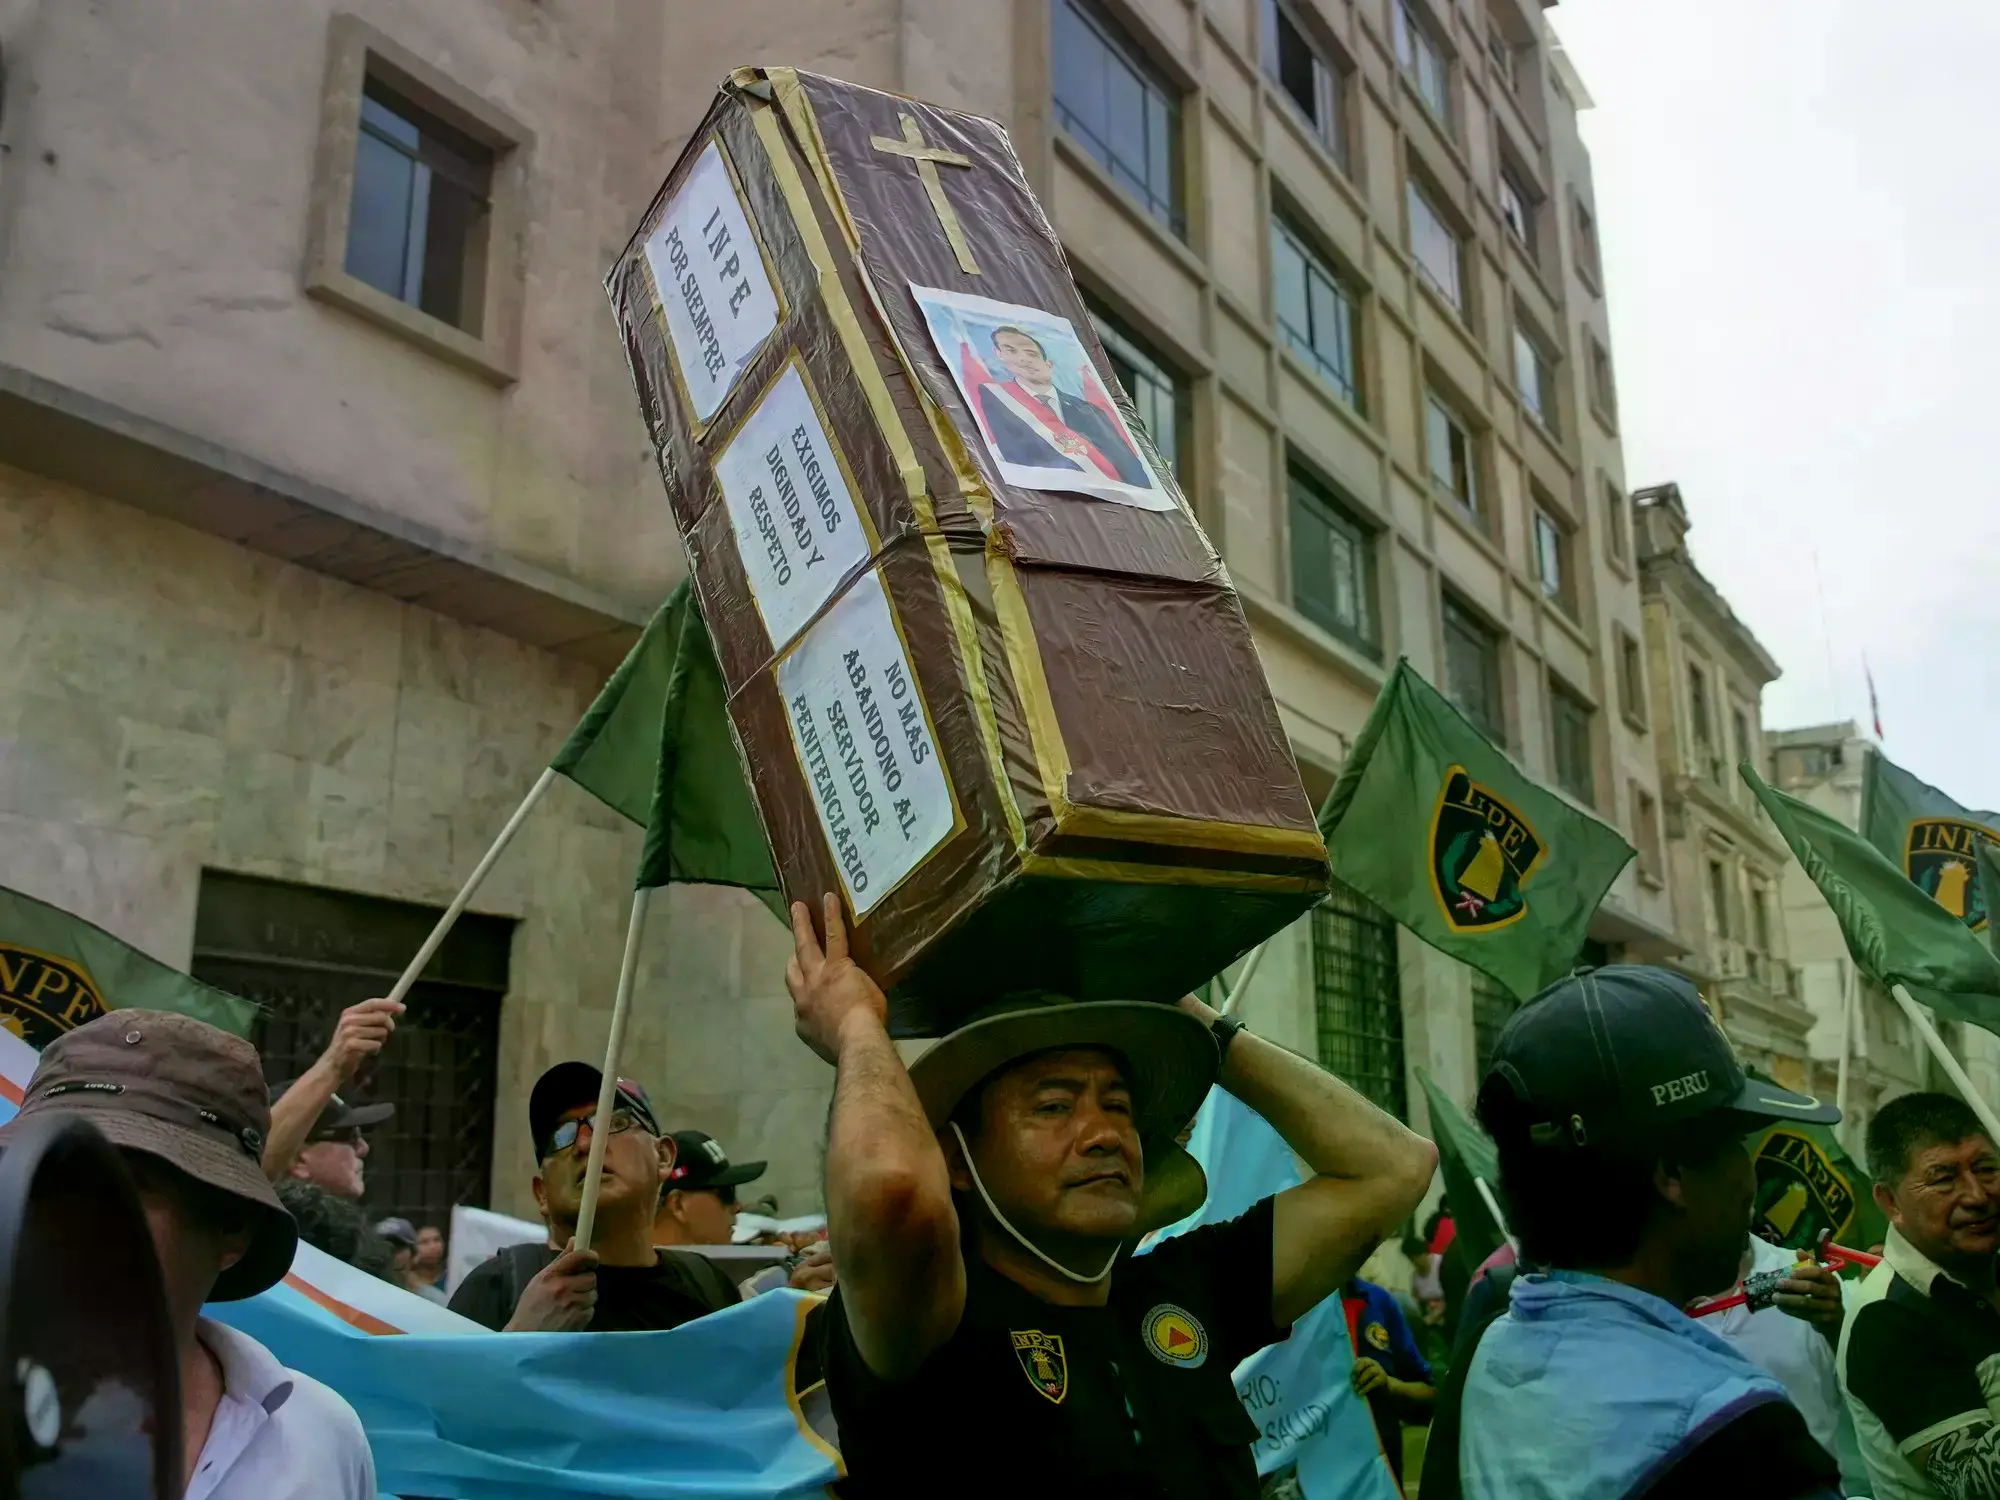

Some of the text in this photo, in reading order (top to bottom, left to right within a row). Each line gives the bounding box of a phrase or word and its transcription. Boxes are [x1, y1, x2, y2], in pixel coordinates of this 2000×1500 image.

[665, 225, 726, 383] POR SIEMPRE
[766, 443, 825, 570] DIGNIDAD Y
[791, 422, 842, 534] EXIGIMOS
[749, 485, 792, 586] RESPETO
[826, 699, 880, 836] SERVIDOR
[843, 649, 917, 841] ABANDONO AL
[884, 659, 930, 765] NO MAS
[792, 691, 868, 893] PENITENCIARIO
[1650, 1070, 1709, 1106] PERU
[1776, 1137, 1846, 1215] INPE
[1012, 1334, 1056, 1352] INPE
